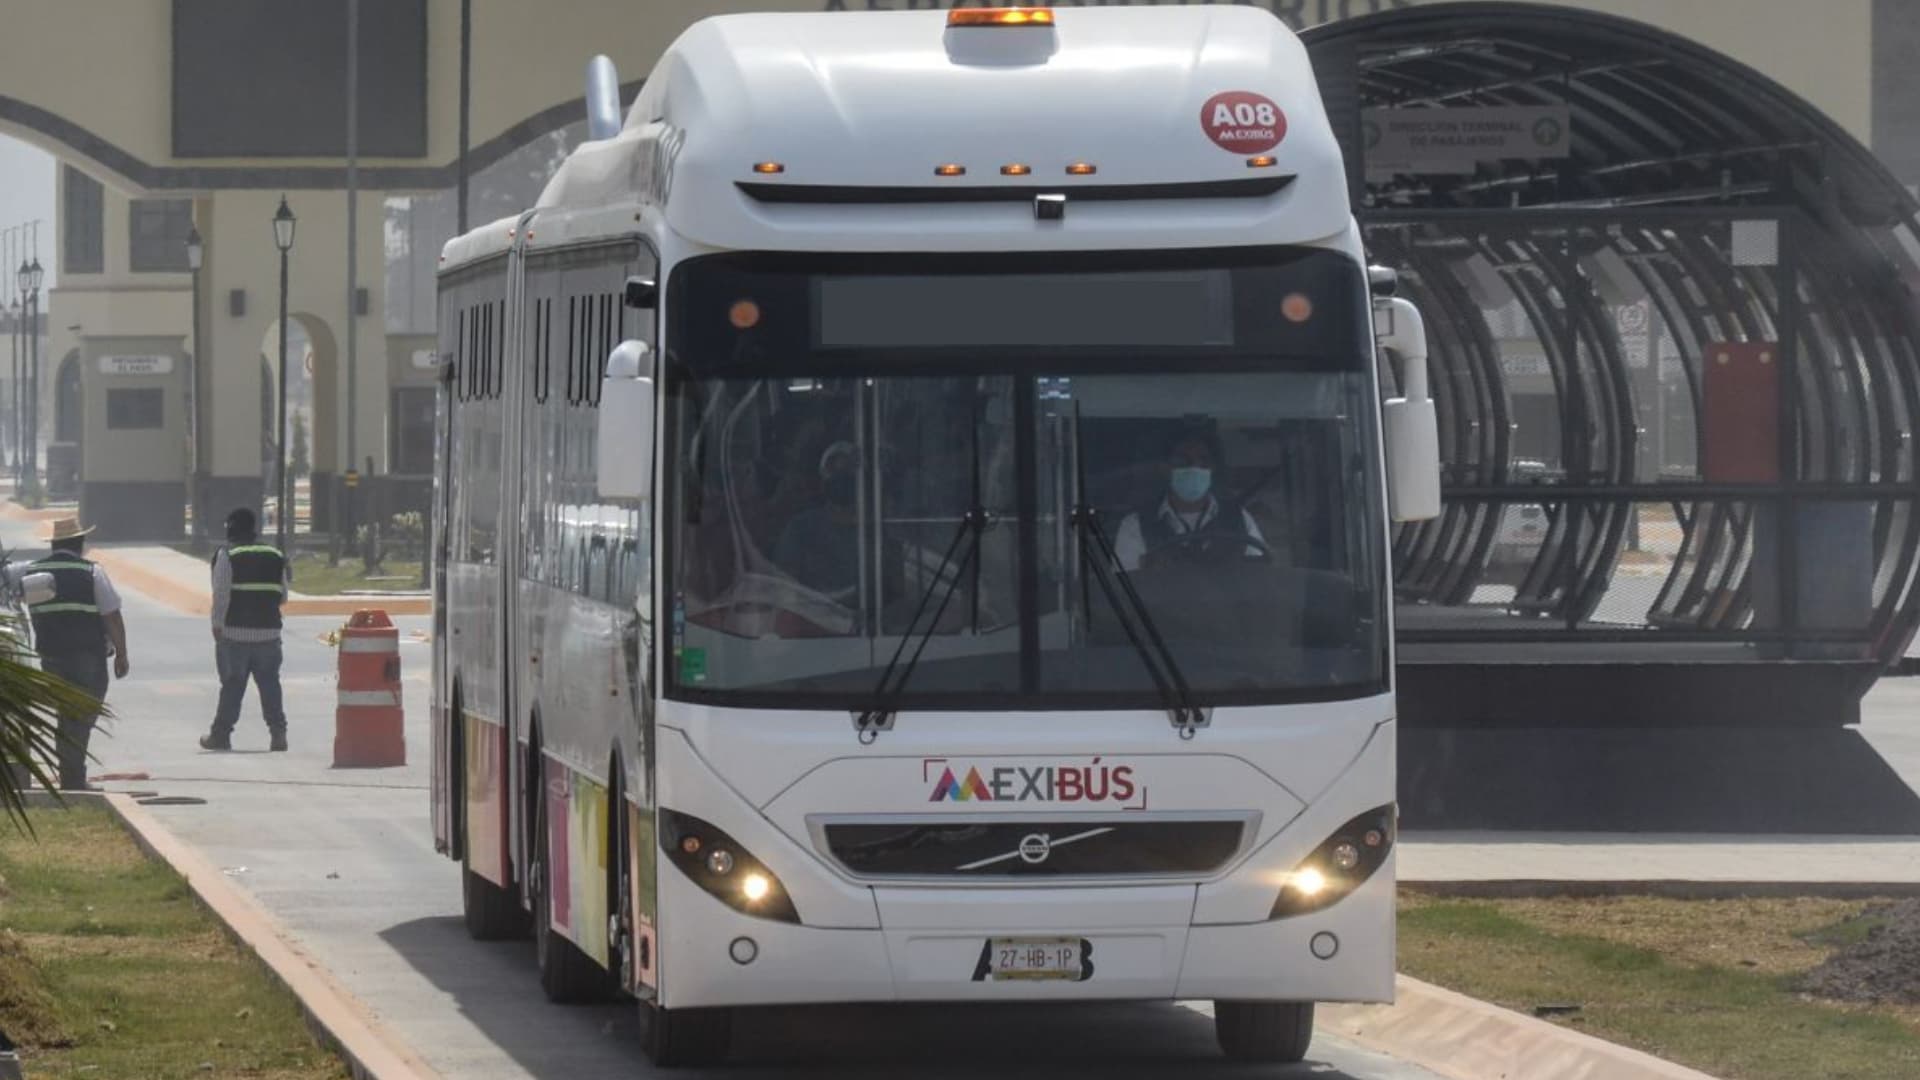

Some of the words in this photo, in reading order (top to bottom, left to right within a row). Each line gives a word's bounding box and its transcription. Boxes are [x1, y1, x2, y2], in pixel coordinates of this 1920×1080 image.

[1212, 102, 1276, 127] A08
[928, 757, 1135, 802] MEXIBÚS
[1000, 948, 1072, 968] 27-HB-1P
